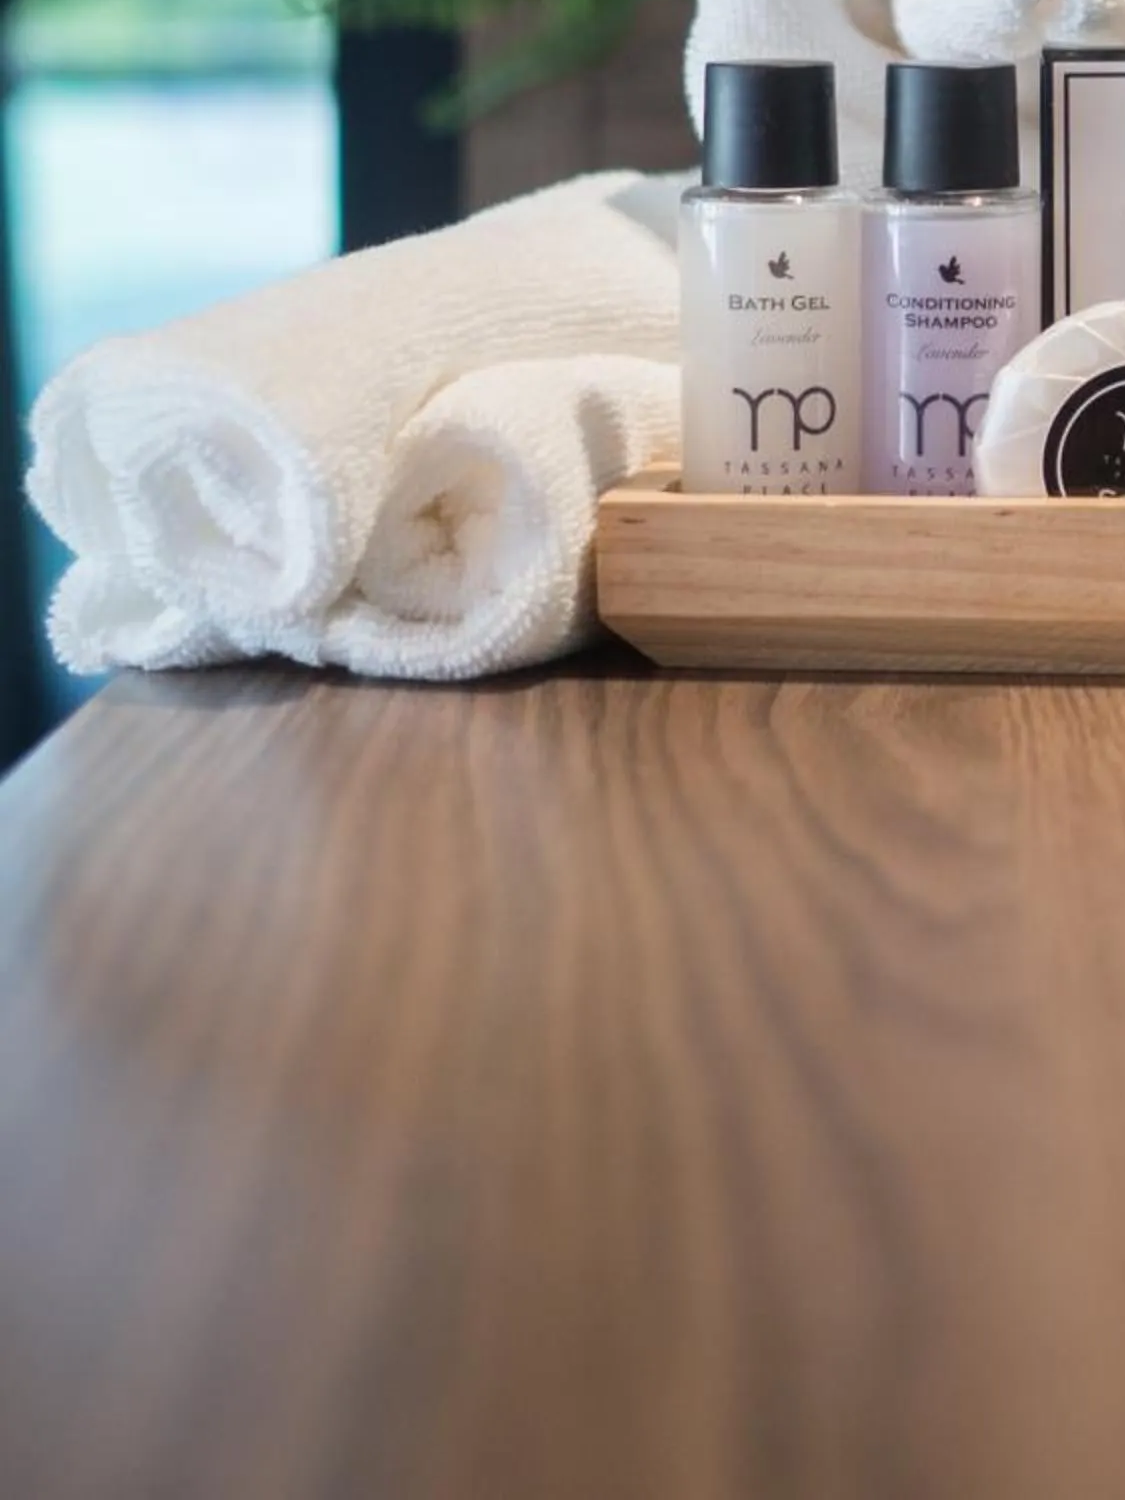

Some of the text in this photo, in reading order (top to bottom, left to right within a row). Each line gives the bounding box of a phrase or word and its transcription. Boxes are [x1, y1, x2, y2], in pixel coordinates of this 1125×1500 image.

[728, 294, 830, 311] BATH GEL
[886, 293, 1016, 311] CONDITIONING
[904, 313, 998, 329] SHAMPOO
[724, 458, 844, 476] TASSANA
[892, 465, 975, 480] TASSA
